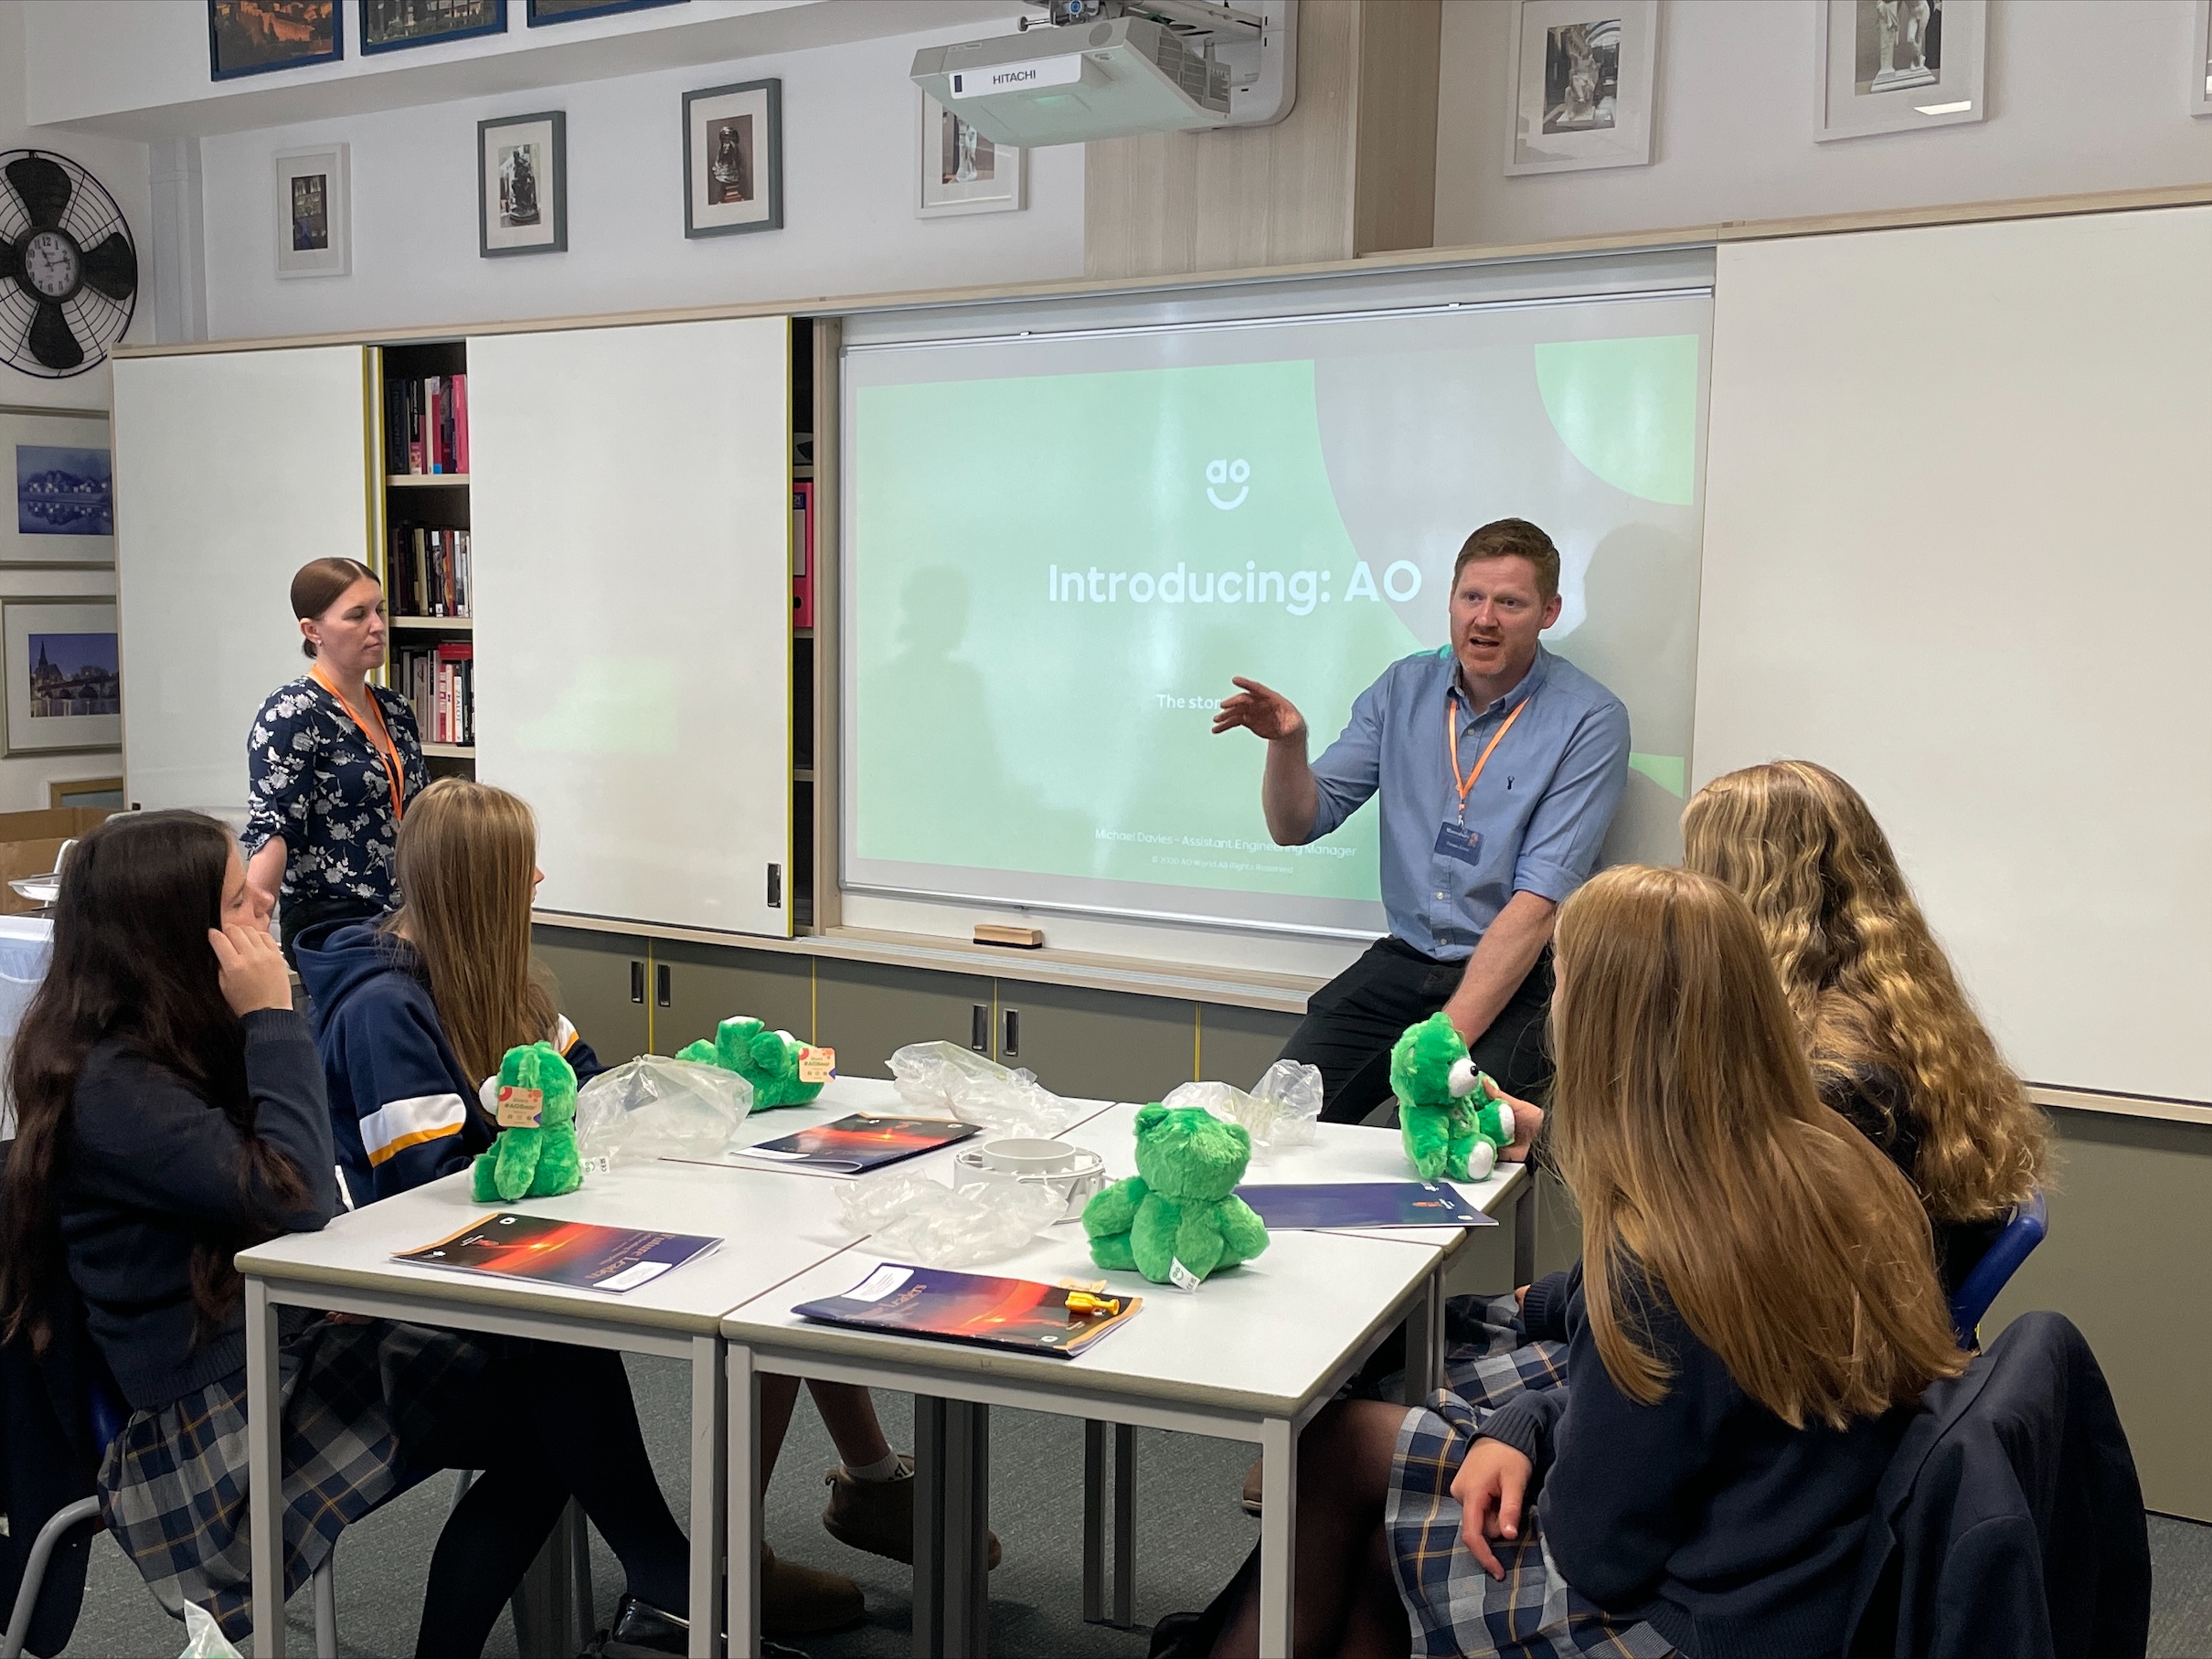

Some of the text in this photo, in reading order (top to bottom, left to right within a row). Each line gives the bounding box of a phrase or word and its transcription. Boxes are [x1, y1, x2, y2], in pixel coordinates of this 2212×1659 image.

[993, 69, 1036, 84] HITACHI
[42, 237, 51, 246] 12
[1206, 459, 1250, 484] ao
[1049, 560, 1422, 616] Introducing: AO
[1156, 694, 1221, 709] The stor
[1095, 828, 1135, 842] Michael
[1137, 832, 1173, 845] Davies
[1181, 835, 1233, 849] Assistant
[1303, 845, 1357, 859] Manager
[1160, 856, 1180, 865] 2020
[1229, 861, 1254, 872] Rights
[505, 1102, 536, 1111] #AOBear
